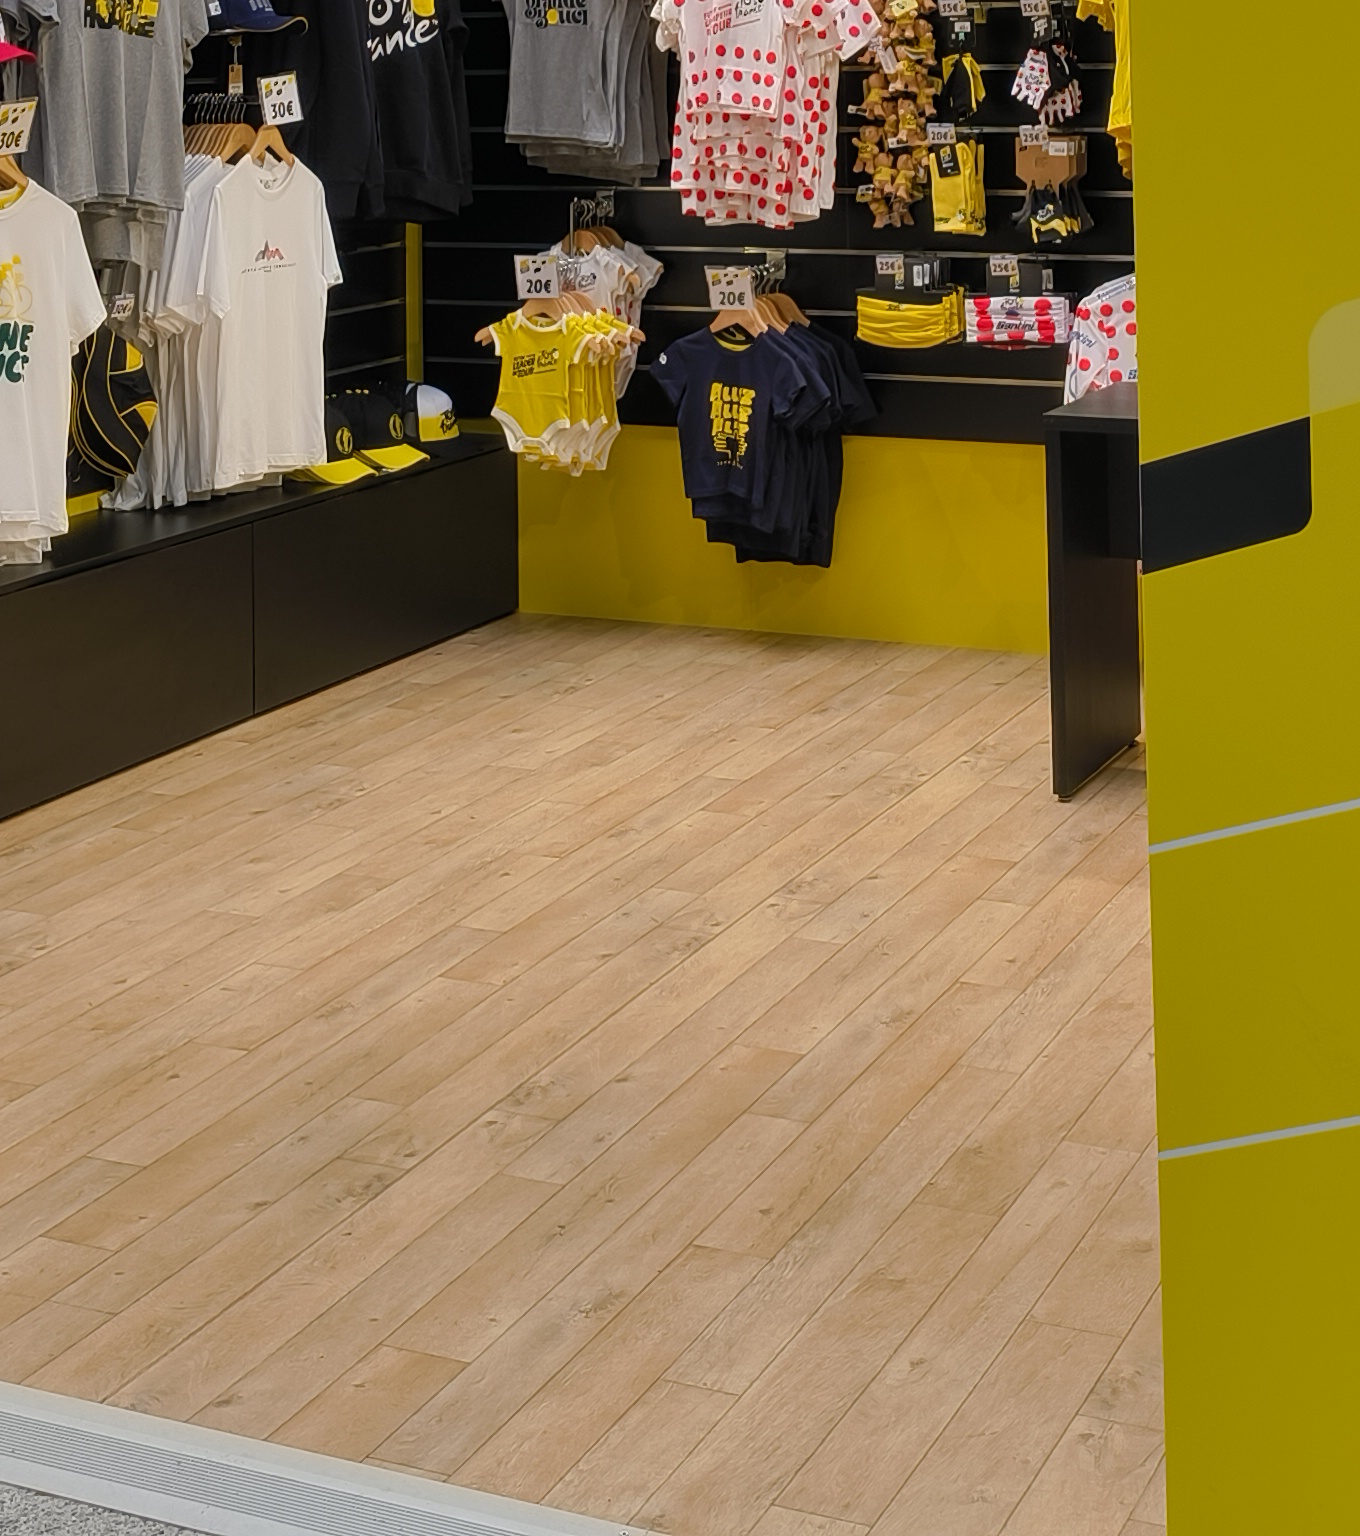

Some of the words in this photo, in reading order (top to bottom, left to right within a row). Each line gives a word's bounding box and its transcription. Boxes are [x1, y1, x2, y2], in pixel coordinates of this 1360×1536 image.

[269, 100, 295, 120] 30€
[526, 279, 552, 293] 20€
[718, 291, 746, 306] 20€
